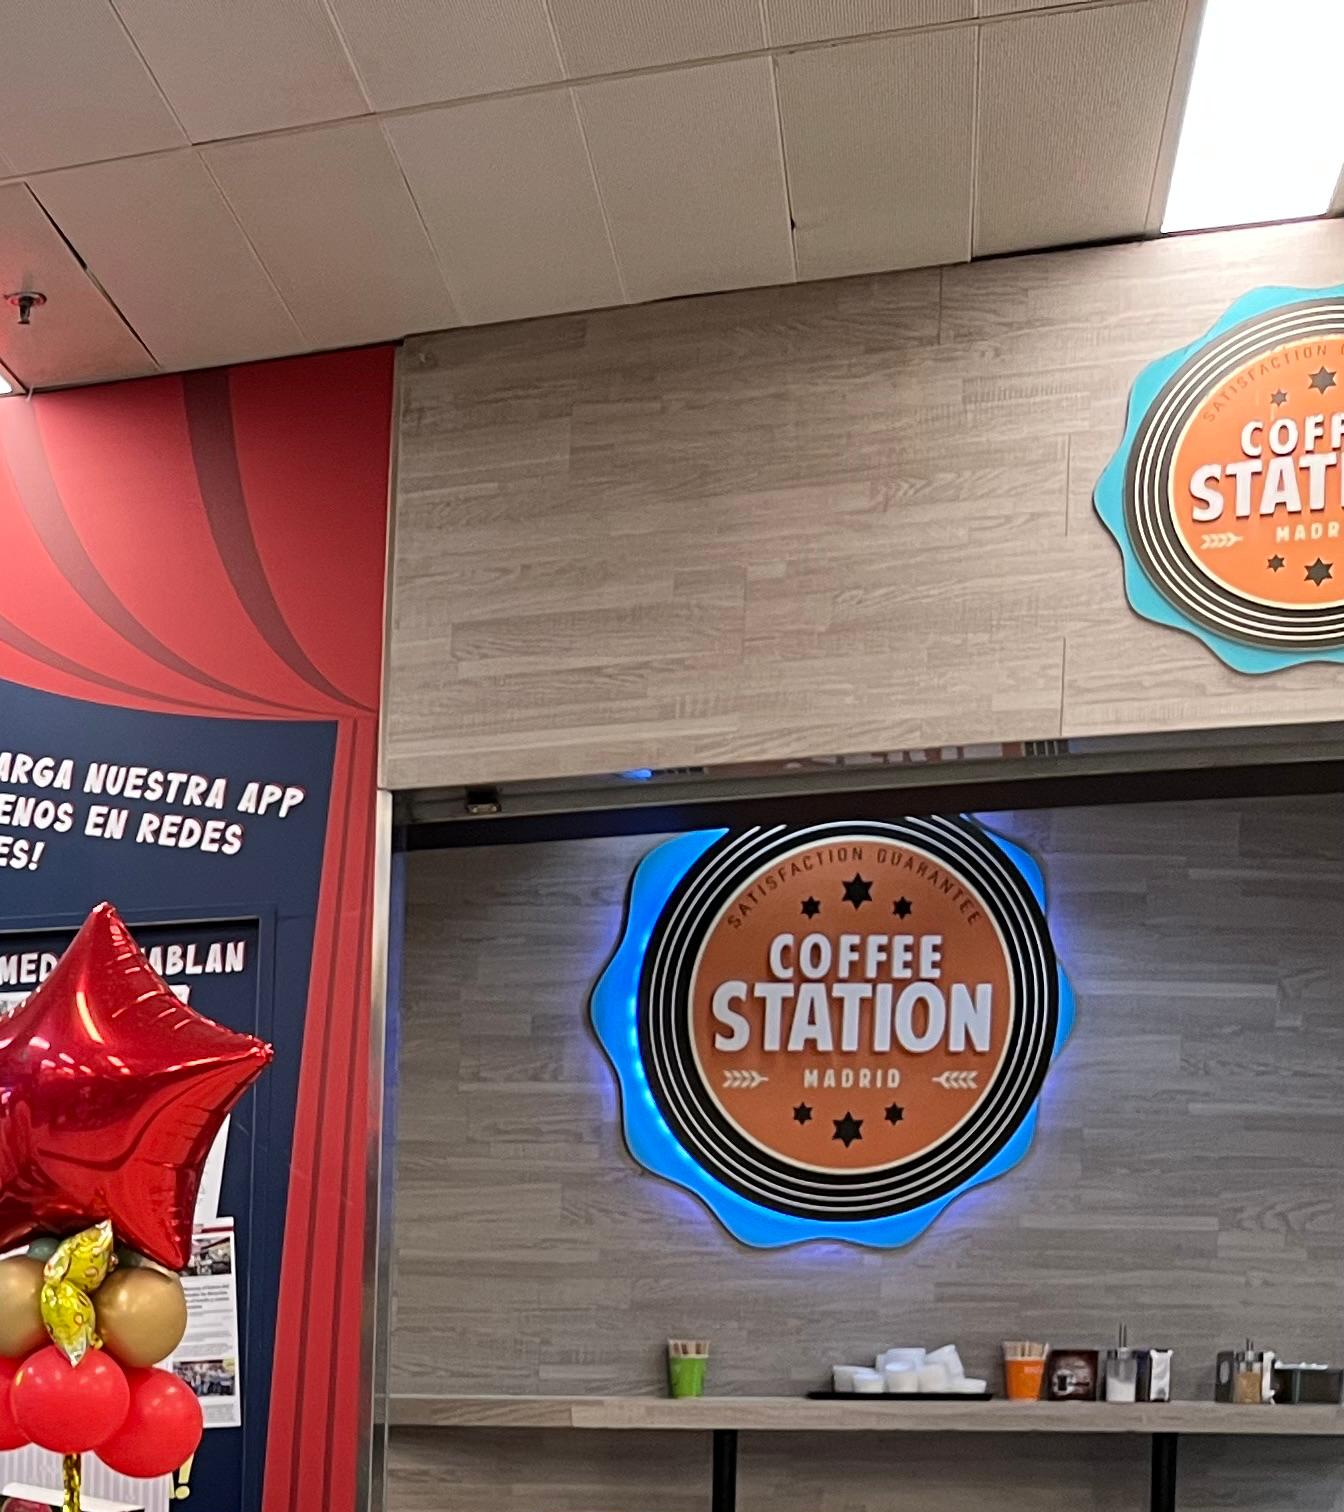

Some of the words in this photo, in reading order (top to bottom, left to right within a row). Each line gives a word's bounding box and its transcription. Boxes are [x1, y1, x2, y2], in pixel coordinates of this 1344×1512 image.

[1202, 344, 1328, 423] SATISFACTION
[1189, 452, 1344, 522] STAT
[83, 762, 227, 810] NUESTRA
[237, 781, 305, 818] APP
[84, 804, 129, 840] EN
[135, 812, 244, 856] REDES
[727, 847, 863, 929] SATISFACTION
[141, 941, 246, 976] ABLAN
[769, 933, 943, 979] COFFEE
[712, 980, 993, 1053] STATION
[803, 1068, 902, 1090] MADRID
